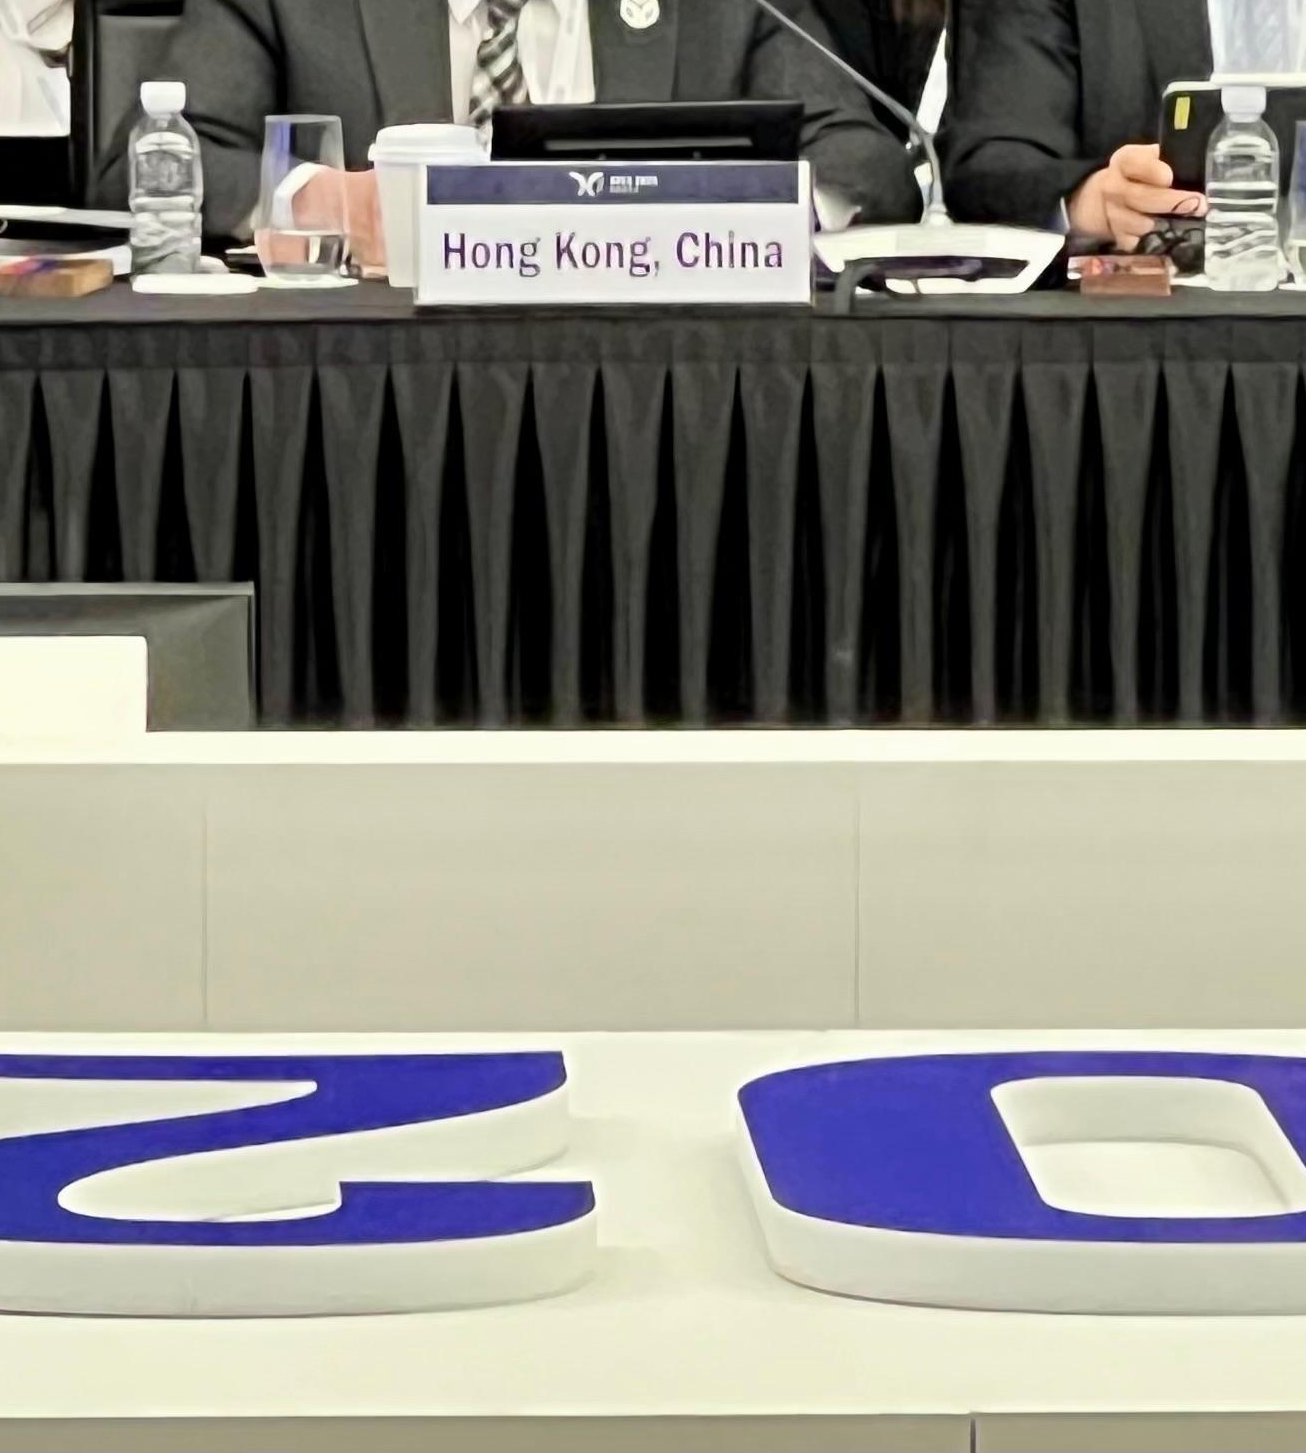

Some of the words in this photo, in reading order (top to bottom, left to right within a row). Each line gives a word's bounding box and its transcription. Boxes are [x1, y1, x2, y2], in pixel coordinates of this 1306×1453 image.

[442, 231, 542, 278] Hong
[554, 230, 660, 278] Kong,
[675, 229, 784, 269] China
